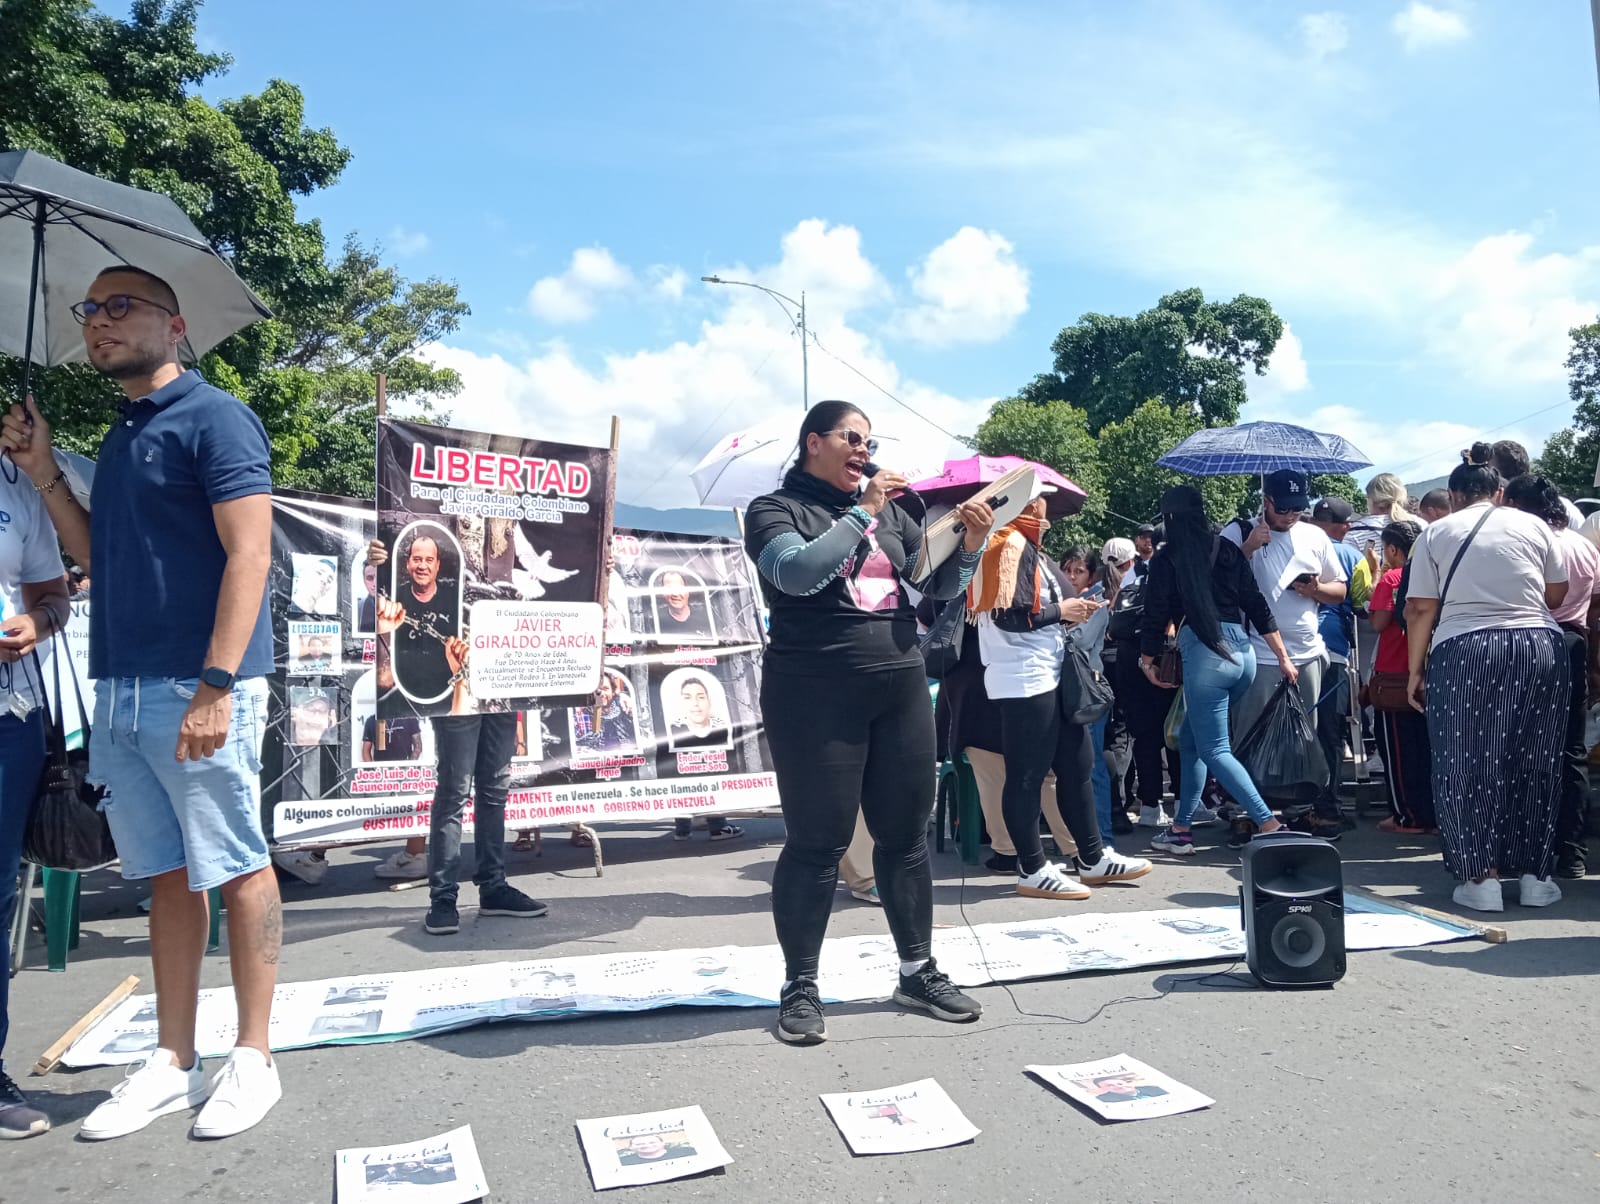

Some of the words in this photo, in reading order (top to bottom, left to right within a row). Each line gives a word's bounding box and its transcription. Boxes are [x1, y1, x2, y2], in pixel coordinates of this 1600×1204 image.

[411, 445, 589, 496] LIBERTAD
[412, 485, 439, 498] Para
[441, 489, 453, 500] el
[456, 489, 520, 506] Ciudadano
[522, 496, 589, 512] Colombiano
[441, 501, 478, 514] Javier
[480, 504, 523, 518] Giraldo
[504, 610, 539, 618] Ciudadano
[540, 610, 579, 618] Colombiano
[291, 624, 339, 634] LIBERTAD
[514, 618, 562, 632] JAVIER
[474, 634, 541, 649] GIRALDO
[509, 658, 539, 666] Detenido
[484, 666, 525, 674] Actualmente
[605, 756, 645, 768] Alejandro
[356, 769, 381, 780] José
[384, 768, 404, 779] Luis
[407, 768, 420, 778] de
[421, 767, 432, 777] la
[351, 780, 399, 792] Asuncion
[284, 808, 333, 824] Algunos
[336, 803, 413, 818] colombianos
[556, 793, 568, 802] en
[571, 788, 622, 802] Venezuela
[630, 786, 642, 797] Se
[645, 785, 668, 796] hace
[671, 782, 708, 795] llamado
[711, 781, 720, 792] al
[721, 777, 773, 791] PRESIDENTE
[363, 815, 414, 831] GUSTAVO
[529, 804, 595, 819] COLOMBIANA
[603, 799, 651, 813] GOBIERNO
[653, 798, 664, 810] DE
[666, 795, 716, 809] VENEZUELA
